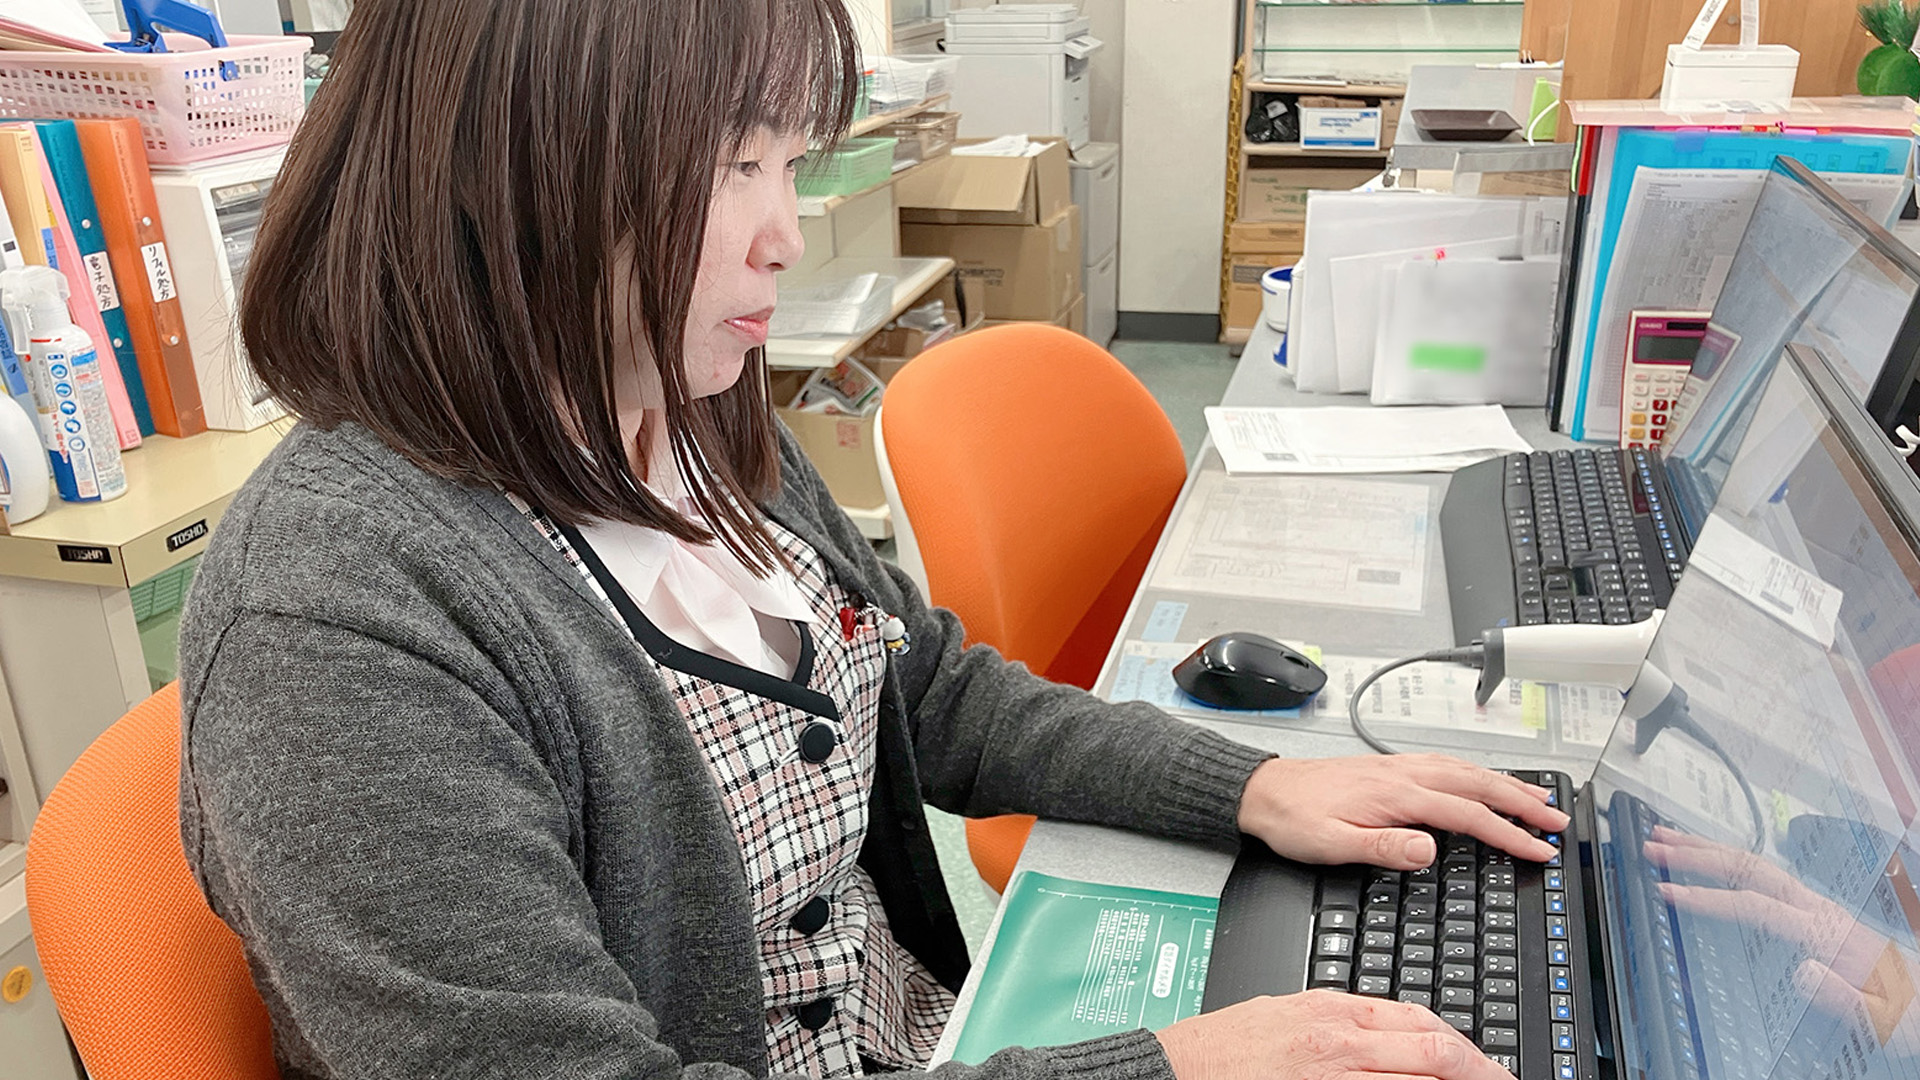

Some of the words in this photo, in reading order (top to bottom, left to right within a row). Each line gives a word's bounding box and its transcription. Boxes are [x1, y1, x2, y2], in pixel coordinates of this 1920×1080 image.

[89, 256, 111, 309] 電子処方
[172, 523, 205, 547] TOSHO
